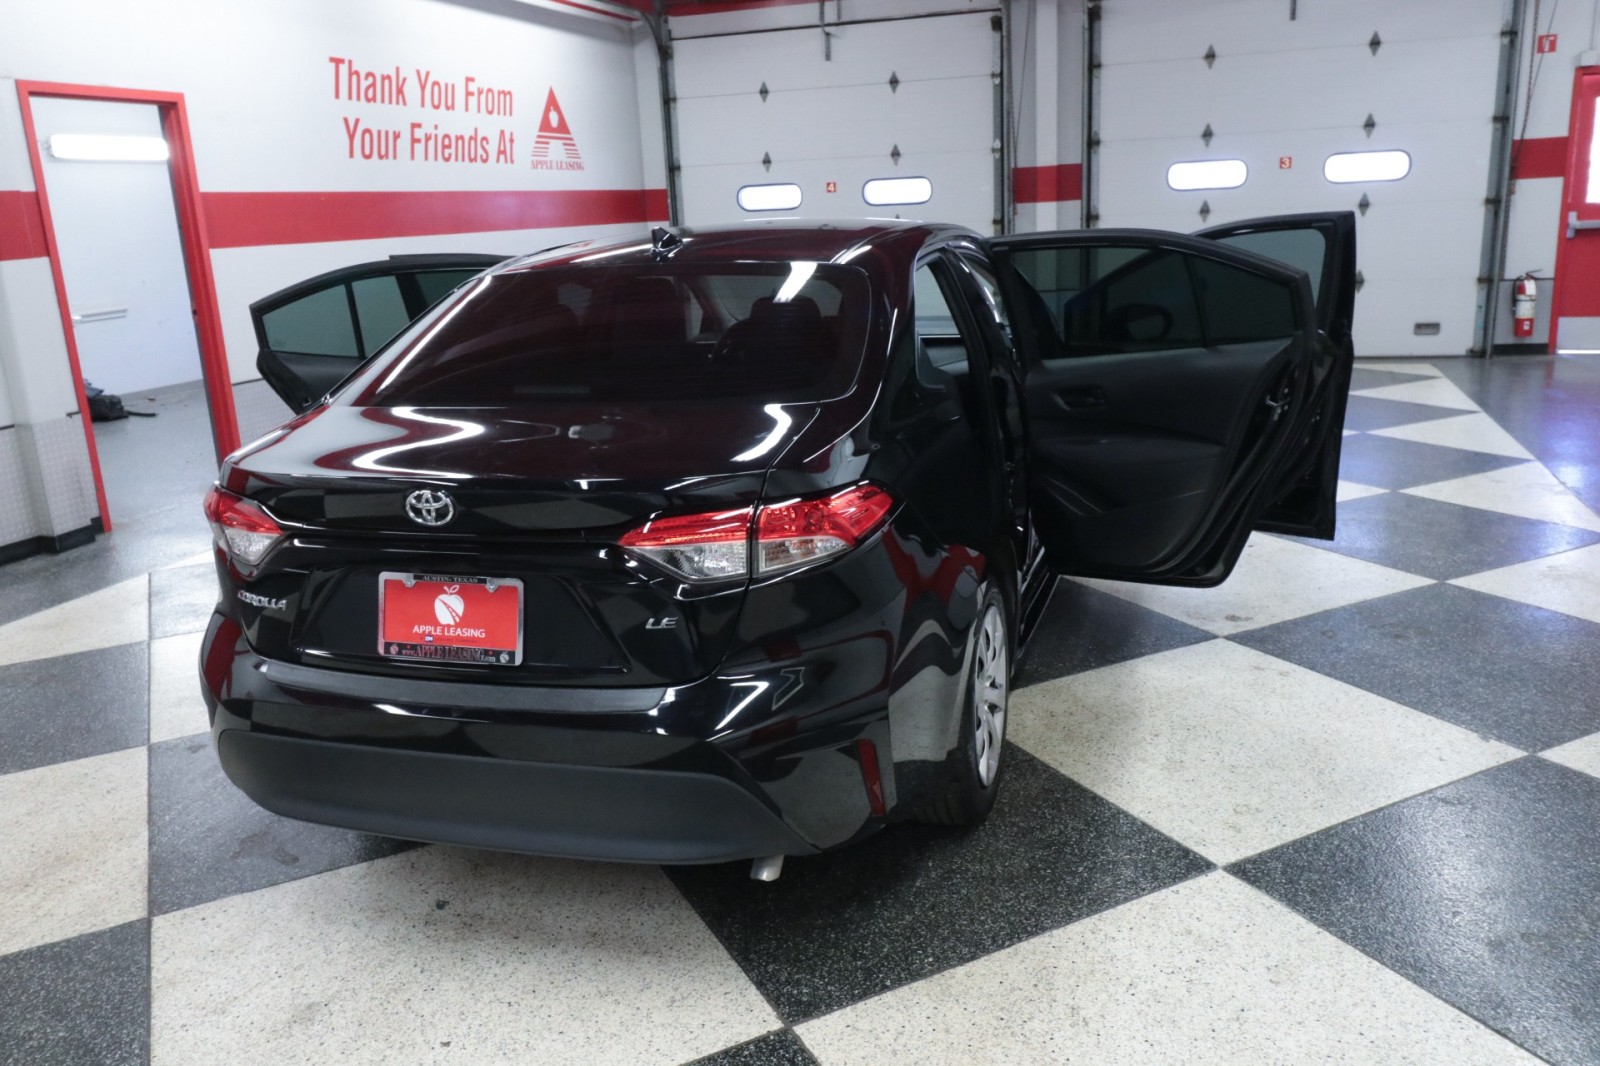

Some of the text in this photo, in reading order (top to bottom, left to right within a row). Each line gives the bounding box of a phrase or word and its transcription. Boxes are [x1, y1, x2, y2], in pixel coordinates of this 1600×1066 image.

[328, 56, 513, 117] Thank You From
[343, 116, 515, 164] Your Friends At
[530, 160, 585, 171] APPLE LEASING
[1281, 157, 1290, 168] 3
[237, 590, 287, 611] COROLLA
[645, 616, 679, 629] LE
[412, 624, 486, 638] APPLE LEASING
